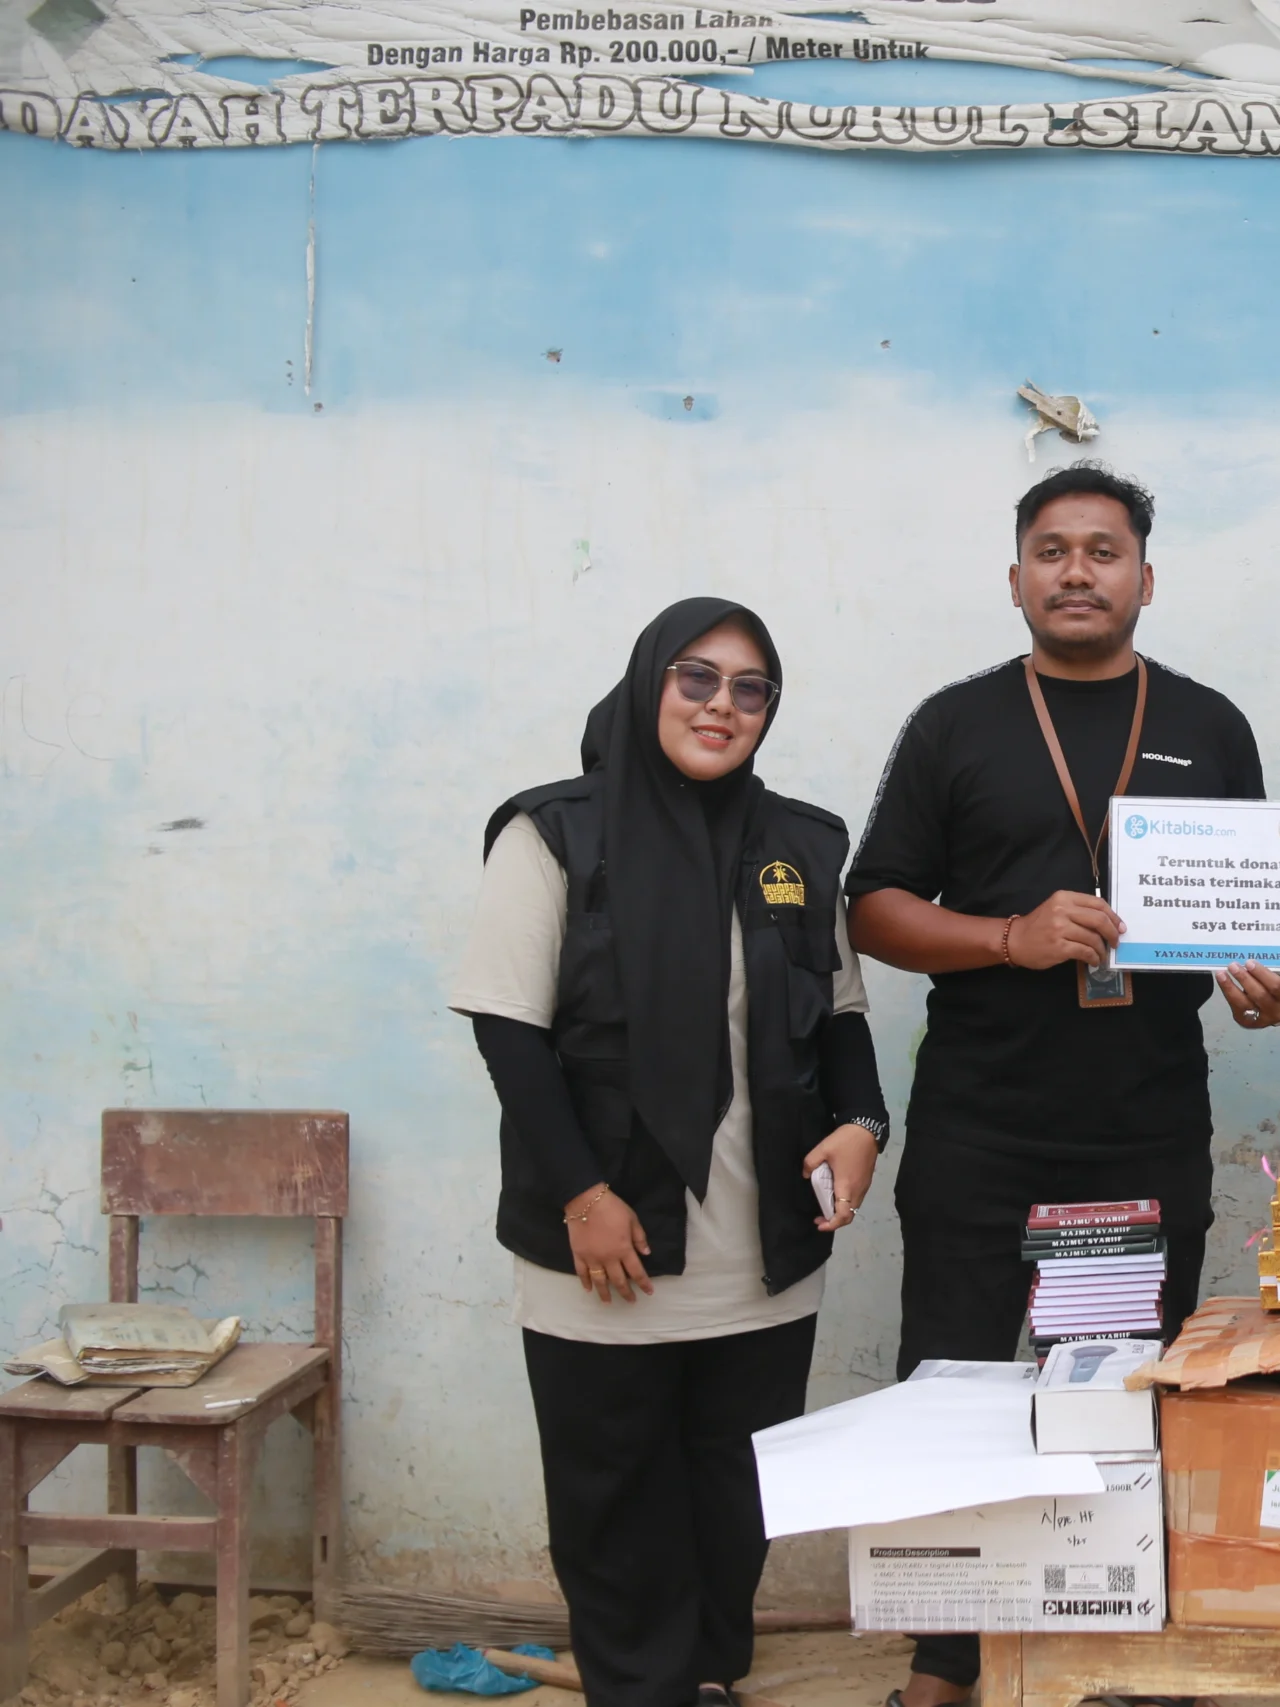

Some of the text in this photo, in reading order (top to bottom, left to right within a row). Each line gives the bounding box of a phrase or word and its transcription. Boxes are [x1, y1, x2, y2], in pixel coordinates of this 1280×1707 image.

[520, 9, 773, 31] Pembebasan Lahan
[367, 43, 463, 68] Dengan
[473, 41, 550, 66] Harga
[560, 41, 600, 68] Rp.
[609, 38, 738, 65] 200.000,-
[766, 37, 843, 60] Meter
[853, 38, 930, 60] Untuk
[0, 87, 287, 148] DAYAH
[300, 73, 703, 140] TERPADU
[720, 91, 1028, 146] NURUL
[1157, 856, 1236, 869] Teruntuk
[1139, 874, 1205, 888] Kitabisa
[1143, 896, 1212, 910] Bantuan
[1215, 897, 1261, 912] bulan
[1192, 920, 1227, 933] saya
[1154, 950, 1204, 960] YAYASAN
[1205, 951, 1246, 960] JEUMPA
[1059, 1215, 1130, 1227] MAJMU' SYARIIF
[1060, 1226, 1132, 1237] MAJMU' SYARIIF
[1052, 1236, 1122, 1247] MAJMU' SYARIIF
[1055, 1247, 1126, 1258] MAJMU' SYARIIF
[1060, 1332, 1131, 1343] MAJMU' SYARIIF
[873, 1547, 950, 1558] Product Description
